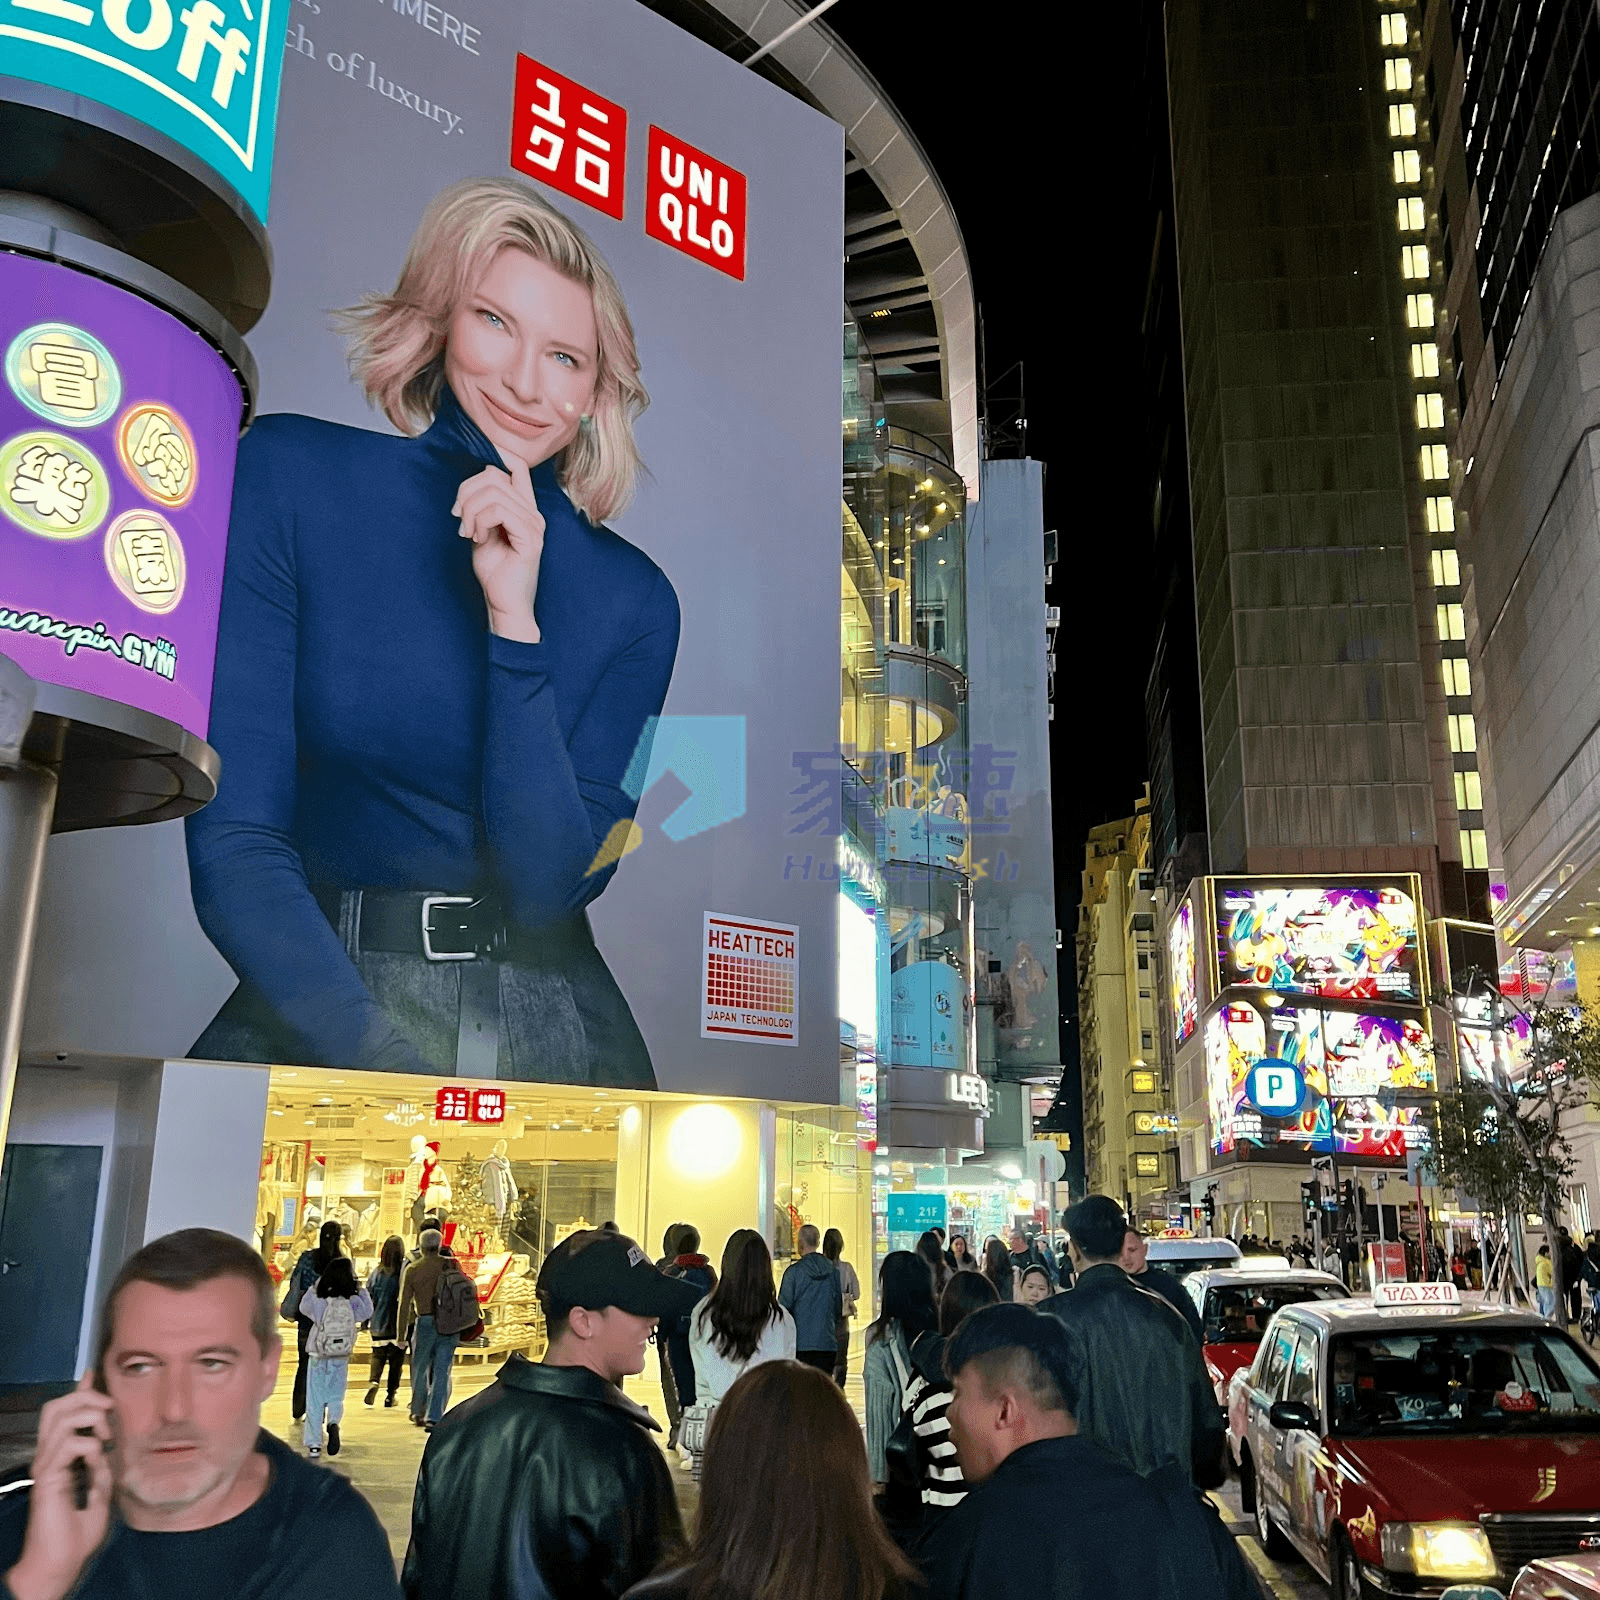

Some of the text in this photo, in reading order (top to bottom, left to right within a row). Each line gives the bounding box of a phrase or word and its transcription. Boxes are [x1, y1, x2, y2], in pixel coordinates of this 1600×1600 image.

[102, 0, 251, 109] off
[327, 52, 365, 80] of
[367, 61, 464, 135] luxury.
[661, 145, 728, 214] UNI
[659, 192, 734, 258] QLO
[122, 634, 176, 681] GYM
[156, 638, 176, 657] USA
[708, 929, 795, 959] HEATTECH
[707, 1010, 794, 1030] JAPAN TECHNOLOGY
[1268, 1075, 1283, 1099] P
[478, 1094, 501, 1106] UNI
[477, 1106, 502, 1118] QLO
[918, 1206, 938, 1217] 21F
[1165, 1229, 1190, 1237] TAXI
[1383, 1286, 1453, 1301] TAXI
